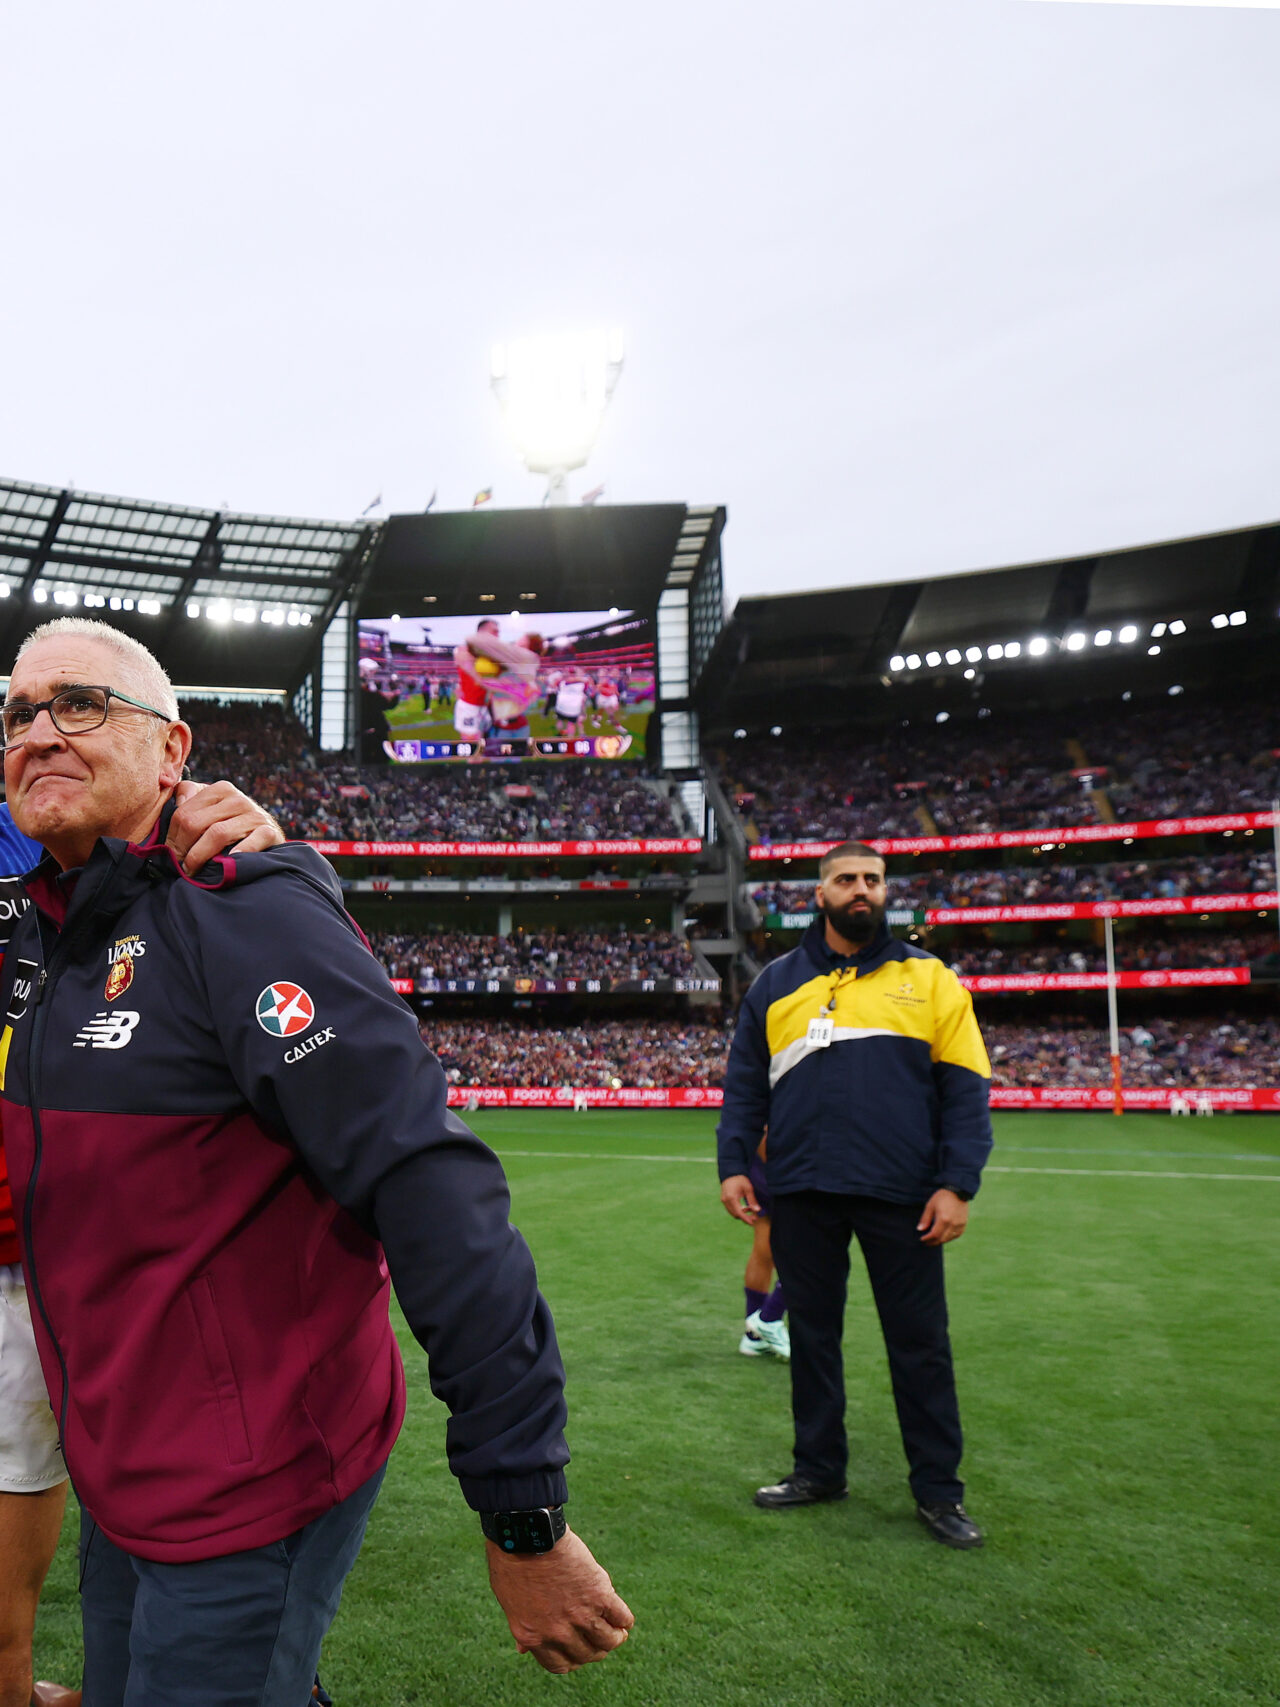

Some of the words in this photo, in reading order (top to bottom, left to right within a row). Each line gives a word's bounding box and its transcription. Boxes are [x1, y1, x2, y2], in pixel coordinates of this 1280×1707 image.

[1184, 816, 1248, 831] TOYOTA
[596, 840, 640, 852] TOYOTA
[646, 840, 686, 851] FOOTY.
[892, 838, 945, 850] TOYOTA
[1025, 829, 1063, 843] WHAT
[371, 842, 414, 853] TOYOTA
[420, 842, 457, 854] FOOTY.
[459, 842, 475, 853] OH
[477, 842, 508, 853] WHAT
[508, 842, 517, 853] A
[517, 842, 562, 853] FEELING!
[1121, 899, 1185, 915] TOYOTA
[961, 908, 1000, 922] WHAT
[107, 940, 147, 965] LIONS
[1004, 975, 1045, 988] WHAT
[1169, 970, 1237, 985] TOYOTA
[283, 1027, 337, 1064] CALTEX
[460, 1089, 507, 1100] TOYOTA
[513, 1089, 554, 1101] FOOTY.
[617, 1089, 669, 1100] FEELING!
[1121, 1089, 1167, 1102] WHAT
